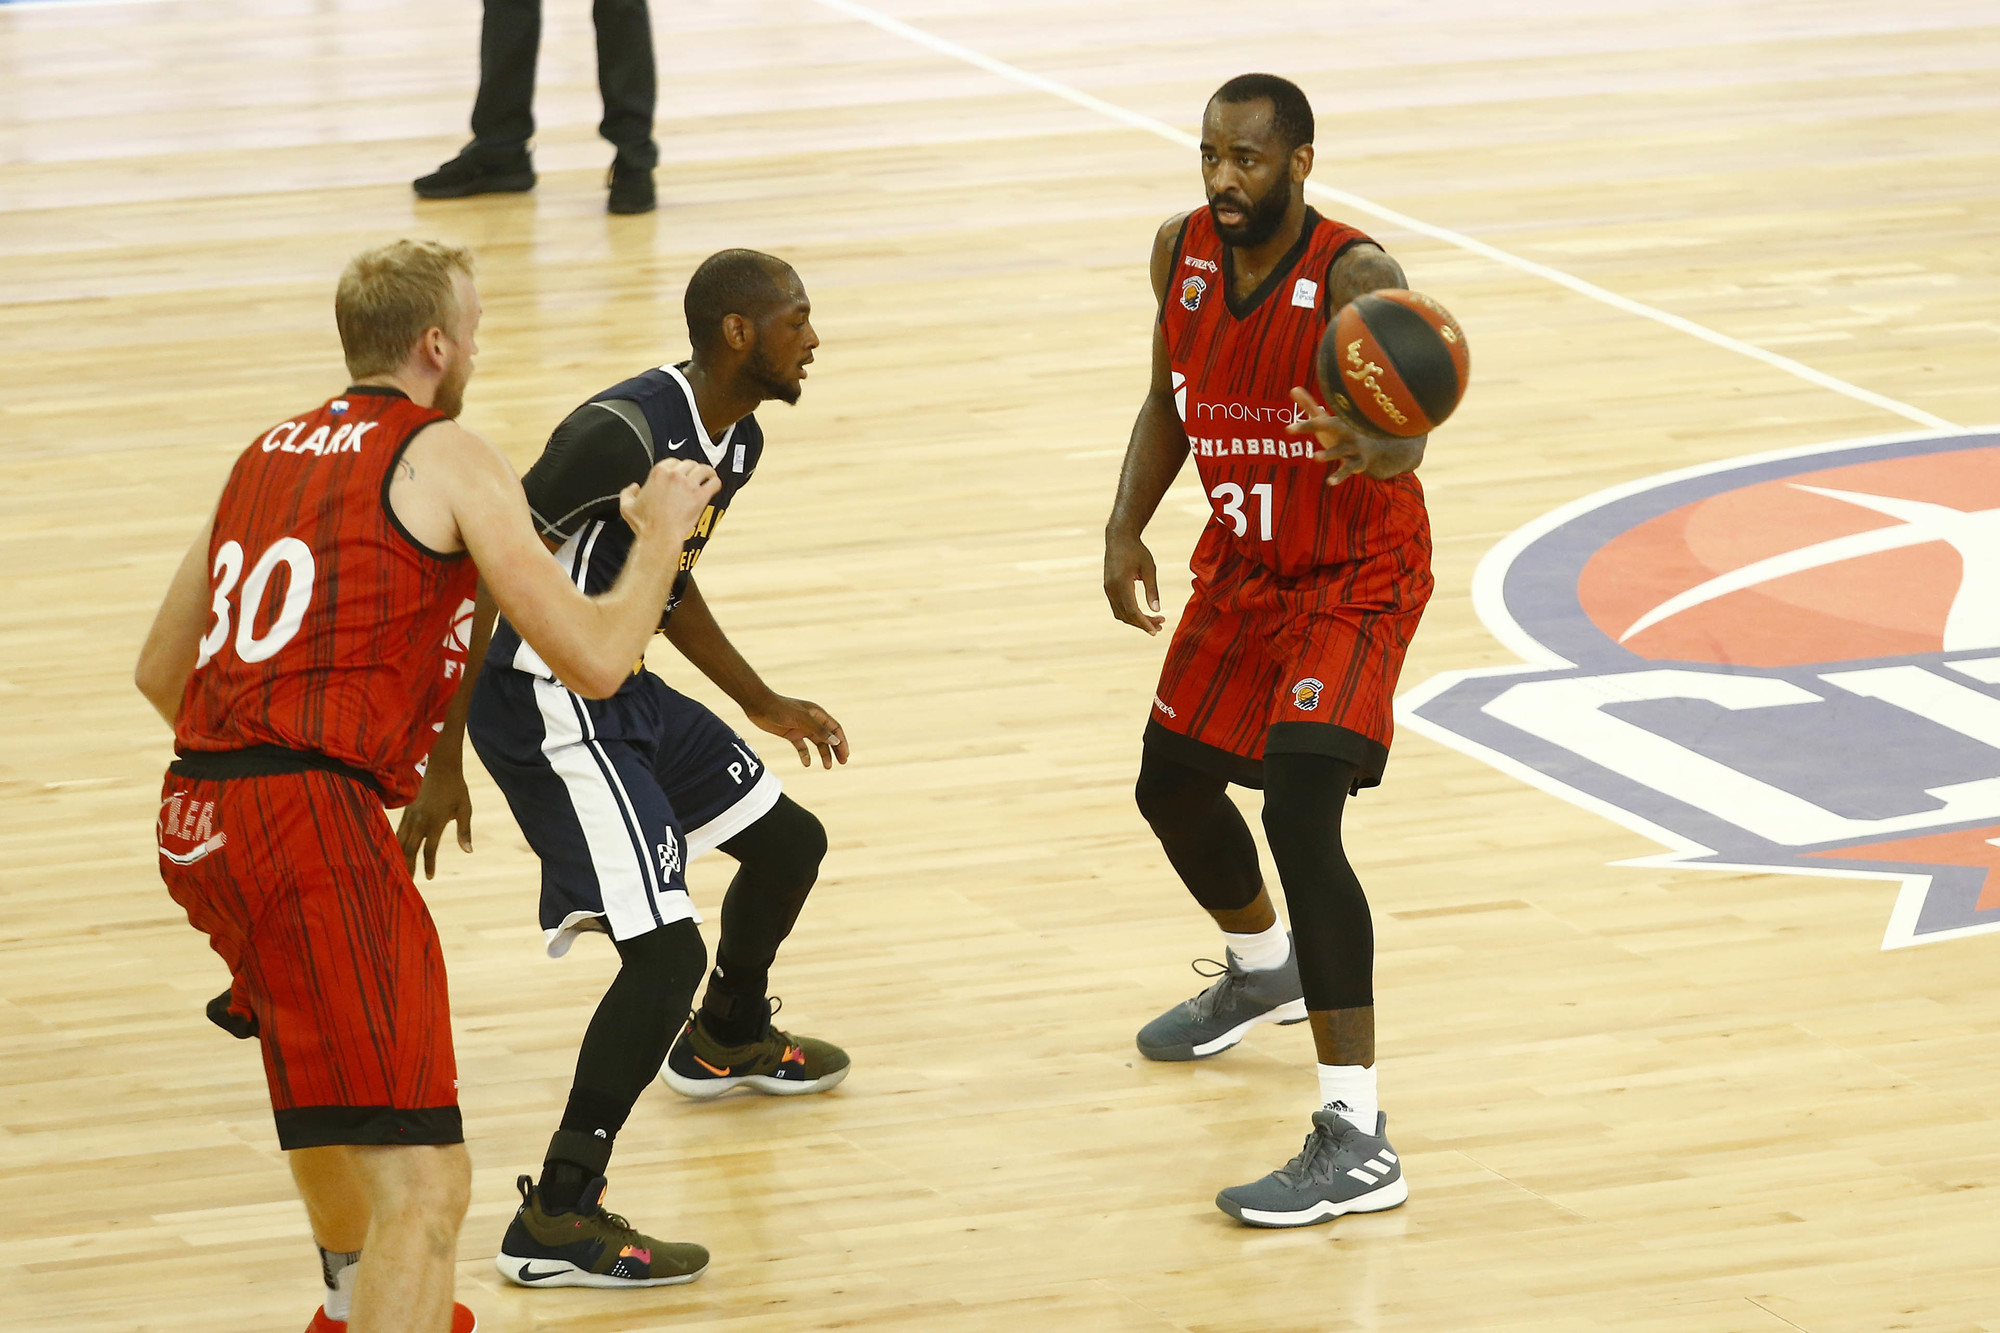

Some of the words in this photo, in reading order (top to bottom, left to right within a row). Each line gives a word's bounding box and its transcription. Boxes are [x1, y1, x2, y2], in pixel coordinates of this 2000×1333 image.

[262, 421, 379, 456] CLARK
[1211, 482, 1273, 541] 31
[195, 536, 316, 668] 30
